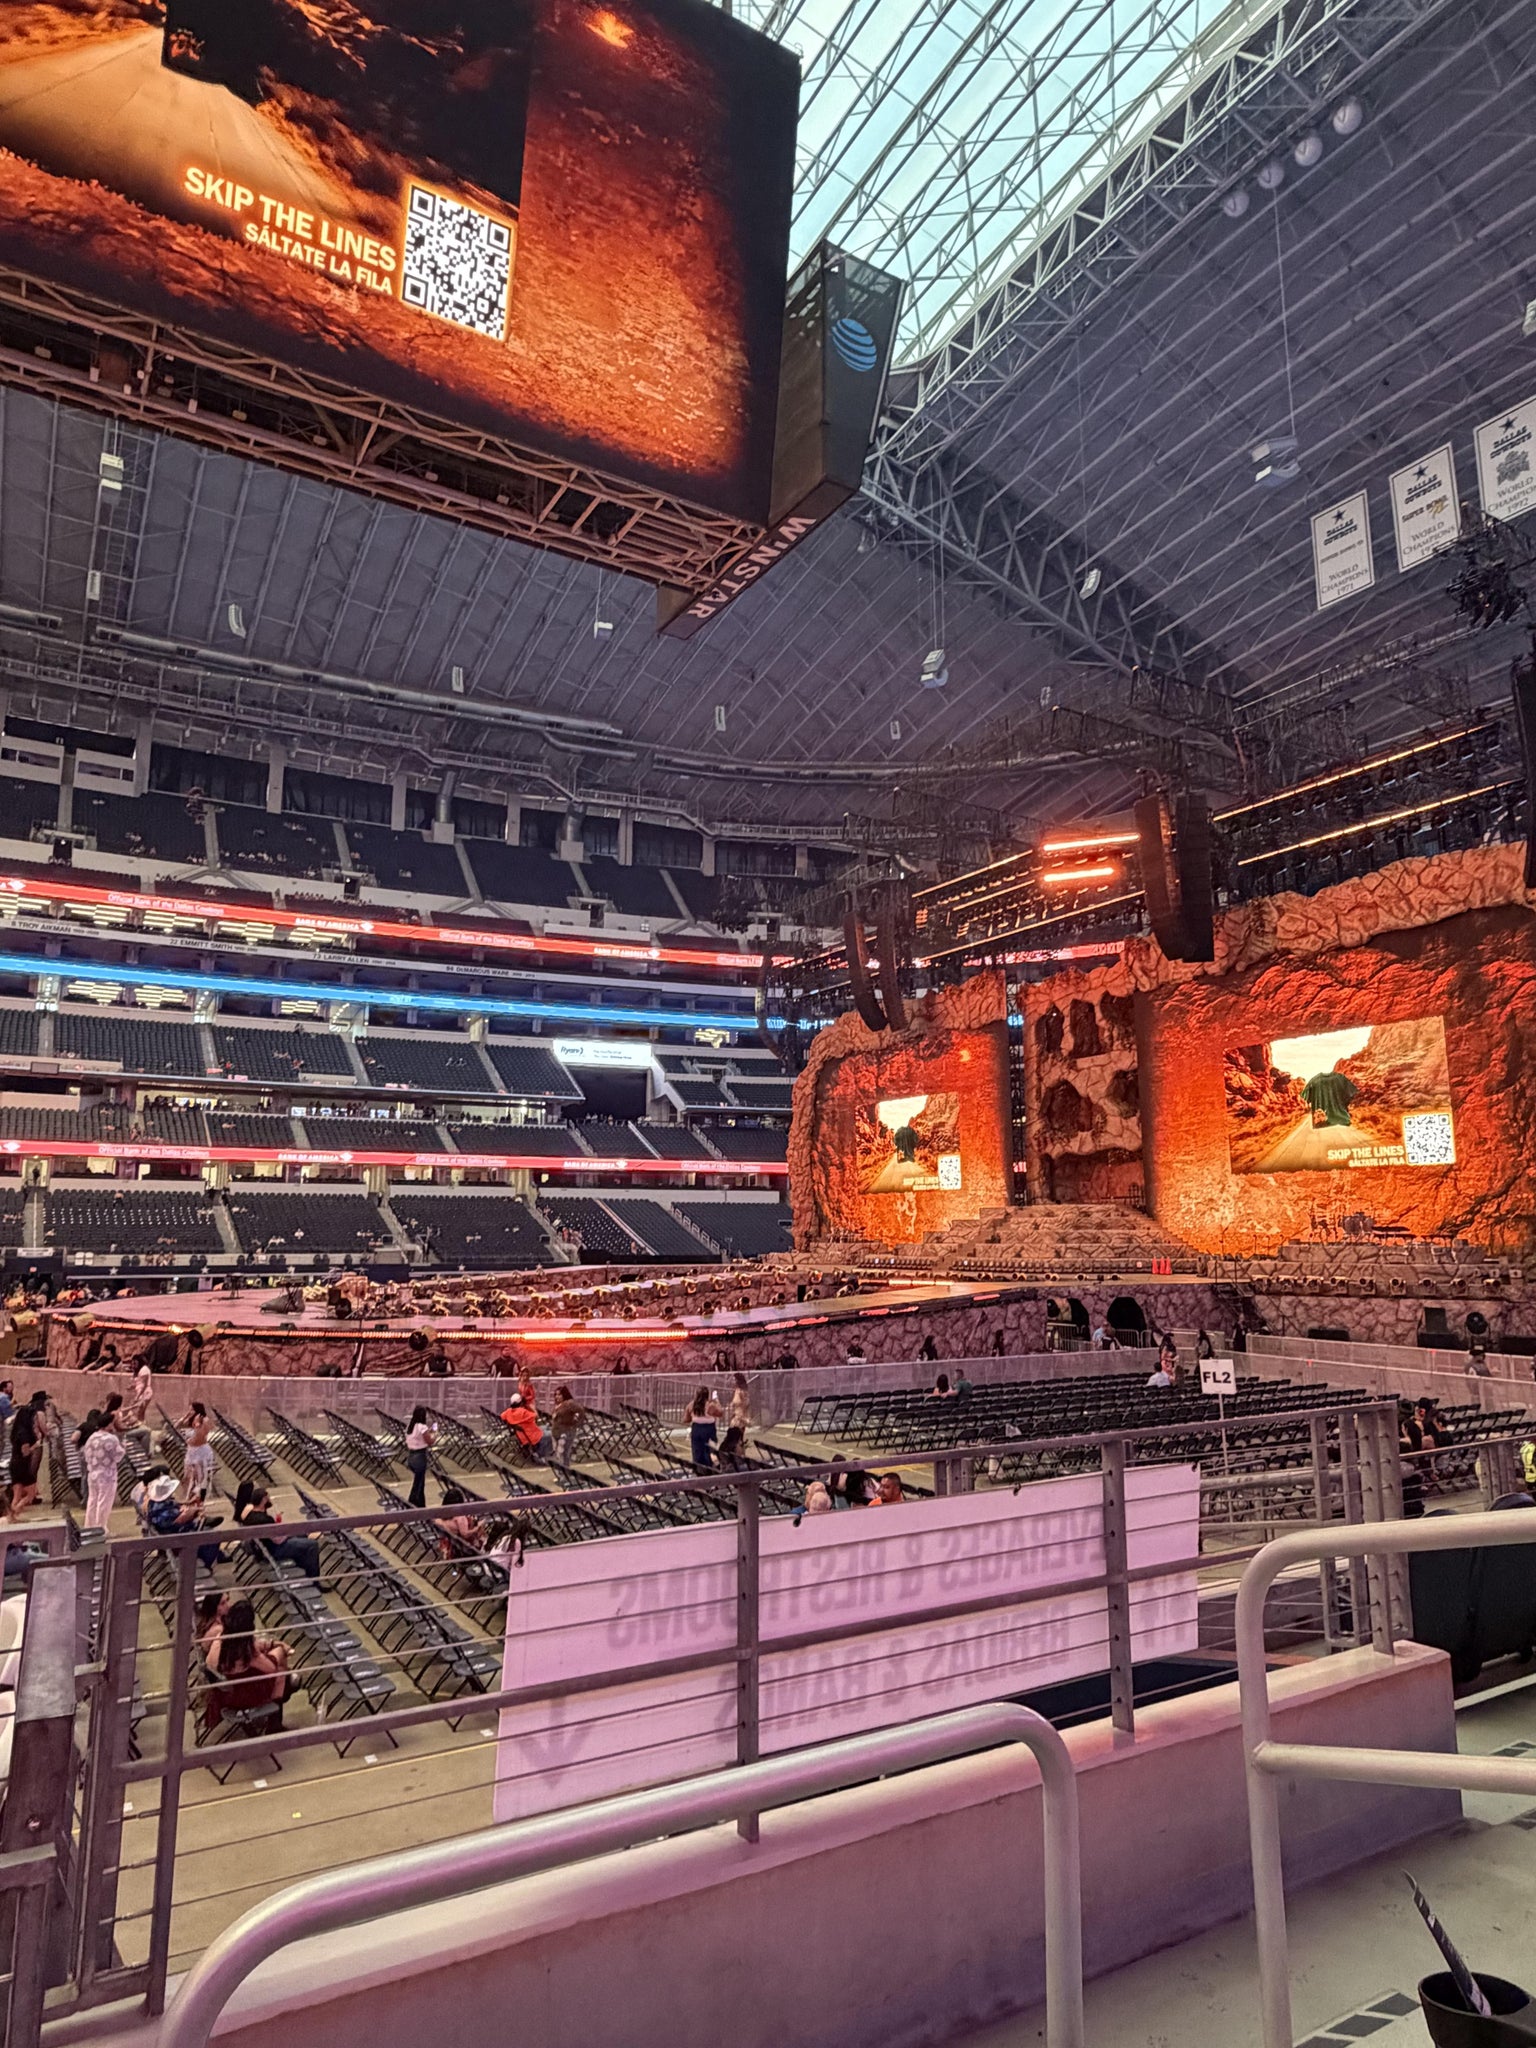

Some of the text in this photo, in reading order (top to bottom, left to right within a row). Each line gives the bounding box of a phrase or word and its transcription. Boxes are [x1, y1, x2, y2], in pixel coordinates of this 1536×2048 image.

[184, 166, 397, 272] SKIP THE LINES
[245, 223, 393, 296] SÁLTATE LA FILA
[1490, 432, 1532, 459] COWBOYS
[1493, 425, 1527, 449] DALLAS
[1404, 480, 1442, 505] COWBOYS
[1407, 474, 1438, 495] DALLAS
[1497, 476, 1534, 498] WORLD
[1326, 518, 1354, 537] DALLAS
[1411, 521, 1444, 542] WORLD
[1403, 525, 1456, 555] CHAMPIONS
[1321, 569, 1369, 594] CHAMPIONS
[1328, 563, 1359, 581] WORLD
[18, 921, 39, 929] TROY
[40, 924, 72, 933] AIKMAN
[180, 939, 209, 948] EMMITT
[210, 943, 233, 951] SMITH
[347, 956, 371, 964] ALLEN
[1327, 1145, 1405, 1161] SKIP THE LINES
[1202, 1371, 1232, 1384] FL2
